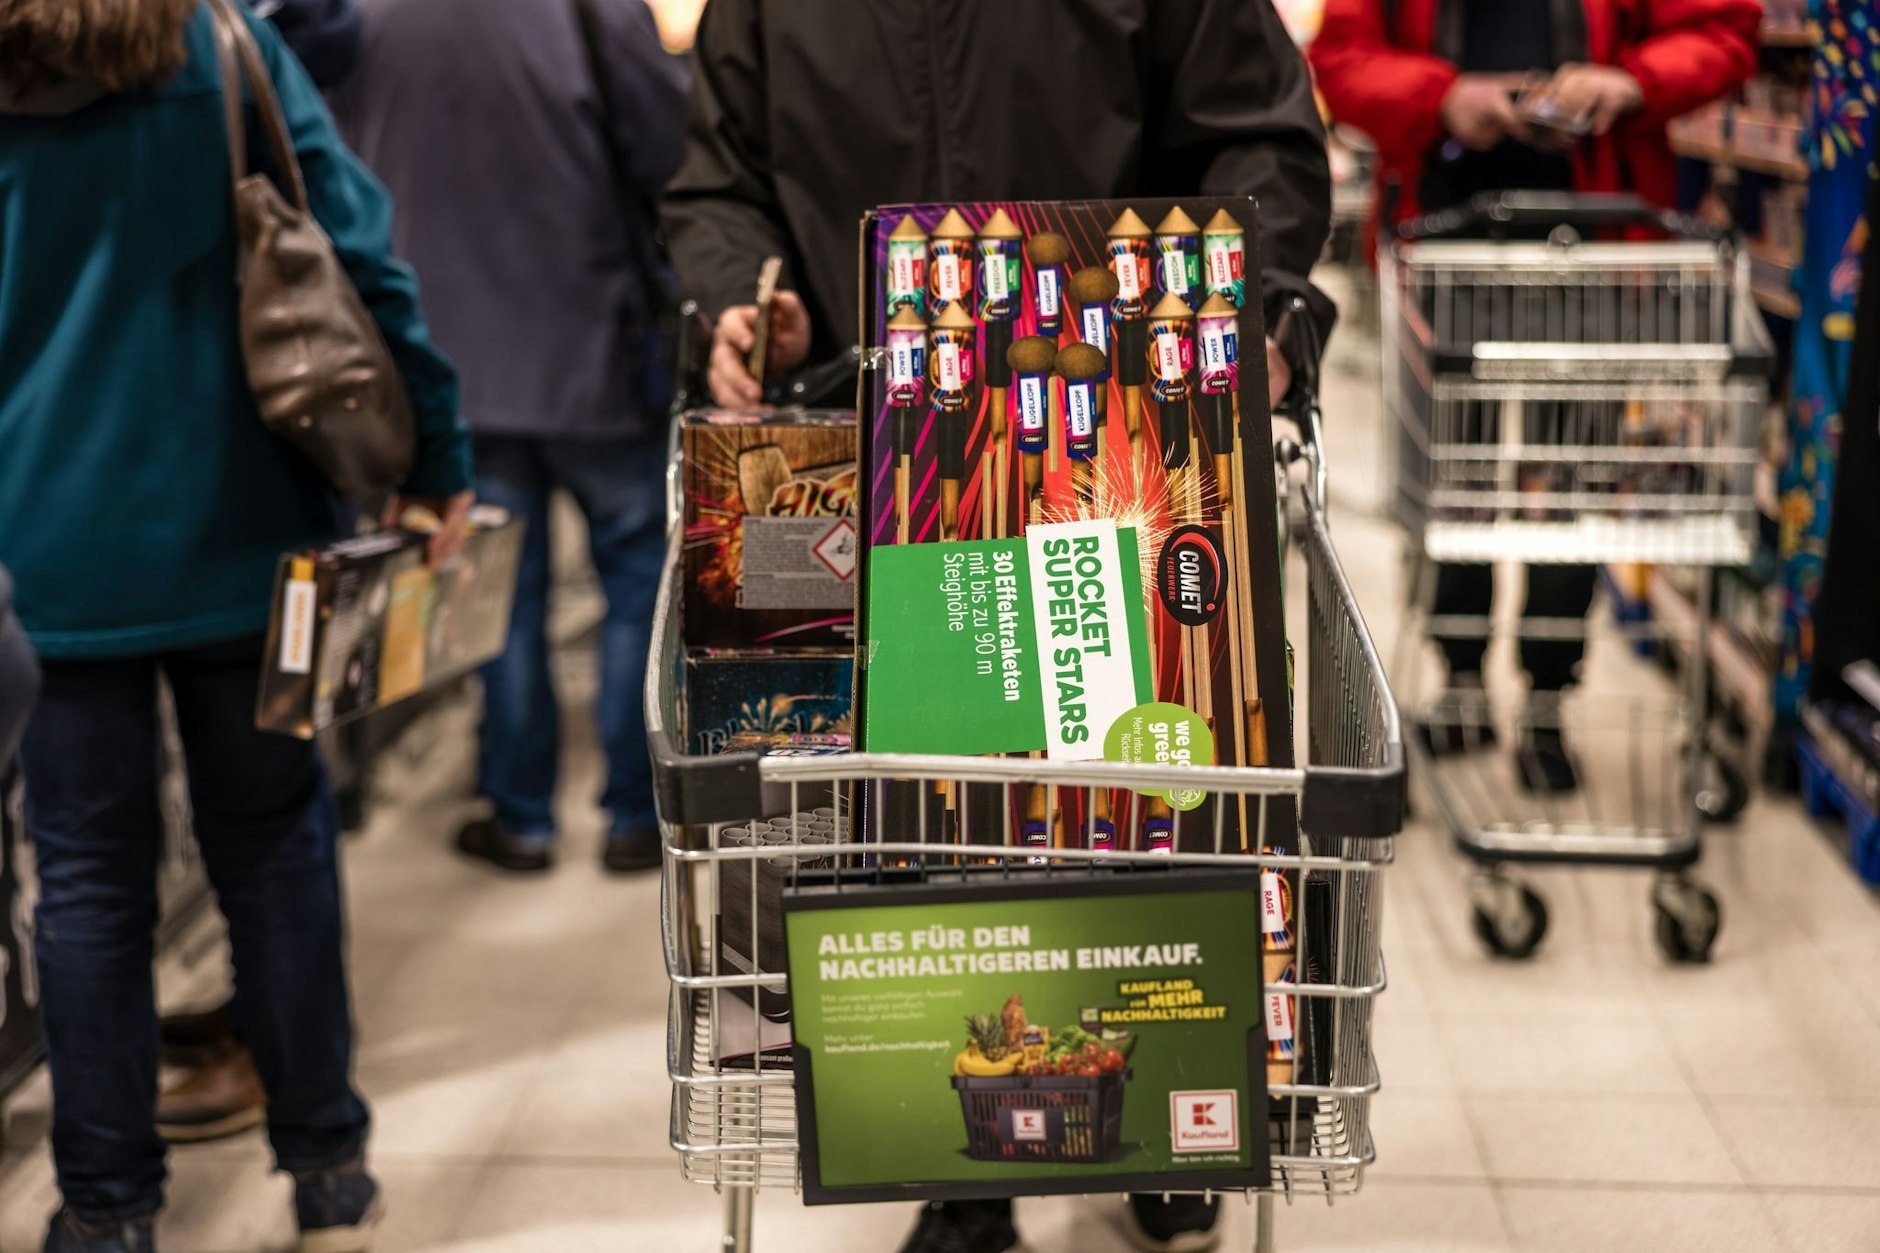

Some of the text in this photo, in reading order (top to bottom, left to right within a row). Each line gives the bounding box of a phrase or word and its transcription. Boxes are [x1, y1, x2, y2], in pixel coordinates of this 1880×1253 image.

[1123, 264, 1131, 287] FEVER
[1171, 255, 1180, 290] FREEDOM
[1216, 251, 1226, 283] BLIZZARD
[1043, 275, 1052, 312] KUGELKOPF
[991, 307, 1010, 315] COMET
[1165, 346, 1173, 366] RAGE
[1210, 338, 1219, 363] POWER
[945, 357, 953, 376] RAGE
[1026, 383, 1036, 425] KUGELKOPF
[1074, 390, 1084, 432] KUGELKOPF
[939, 552, 969, 632] Steighöhe
[1167, 556, 1176, 603] FEUERWERK
[1178, 550, 1202, 614] COMET
[1072, 536, 1112, 657] ROCKET
[968, 551, 996, 675] mit bis zu 90 m
[993, 550, 1023, 702] 30 Effektraketen
[1043, 539, 1089, 745] SUPER STARS
[1133, 717, 1143, 736] Mehr
[1175, 720, 1191, 747] we
[1134, 737, 1143, 755] Infos
[1263, 890, 1275, 916] RAGE
[818, 924, 1031, 955] ALLES FÜR DEN
[819, 942, 1204, 981] NACHHALTIGEREN EINKAUF.
[1120, 979, 1194, 994] KAUFLAND
[1147, 989, 1204, 1008] MEHR
[1101, 1006, 1226, 1023] NACHHALTIGKEIT
[1271, 995, 1282, 1027] FEVER
[1181, 1130, 1229, 1139] Kaufland
